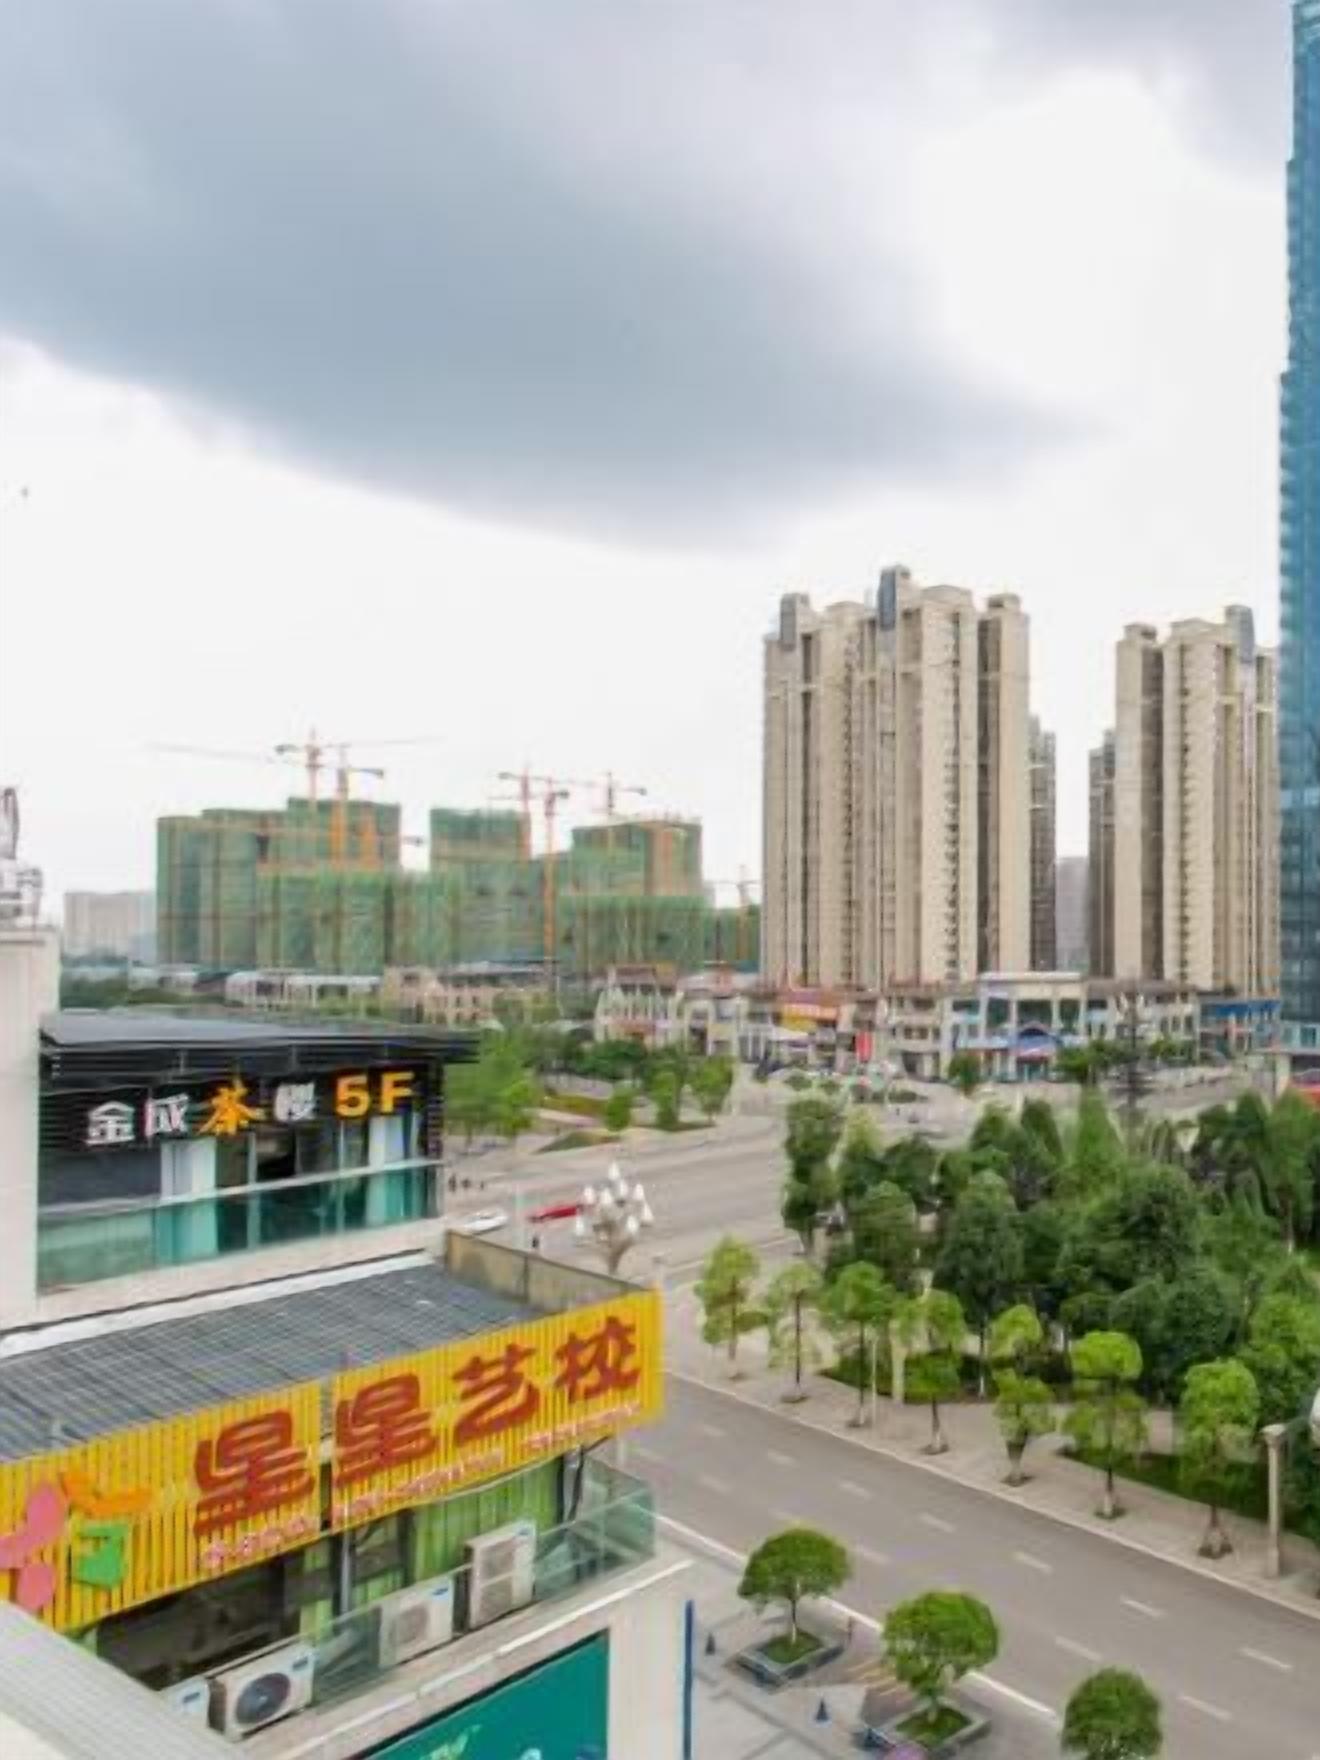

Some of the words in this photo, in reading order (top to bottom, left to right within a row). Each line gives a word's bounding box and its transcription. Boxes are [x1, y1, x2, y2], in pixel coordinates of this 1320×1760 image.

[335, 1072, 414, 1118] 5F
[193, 1316, 641, 1536] 星星艺校
